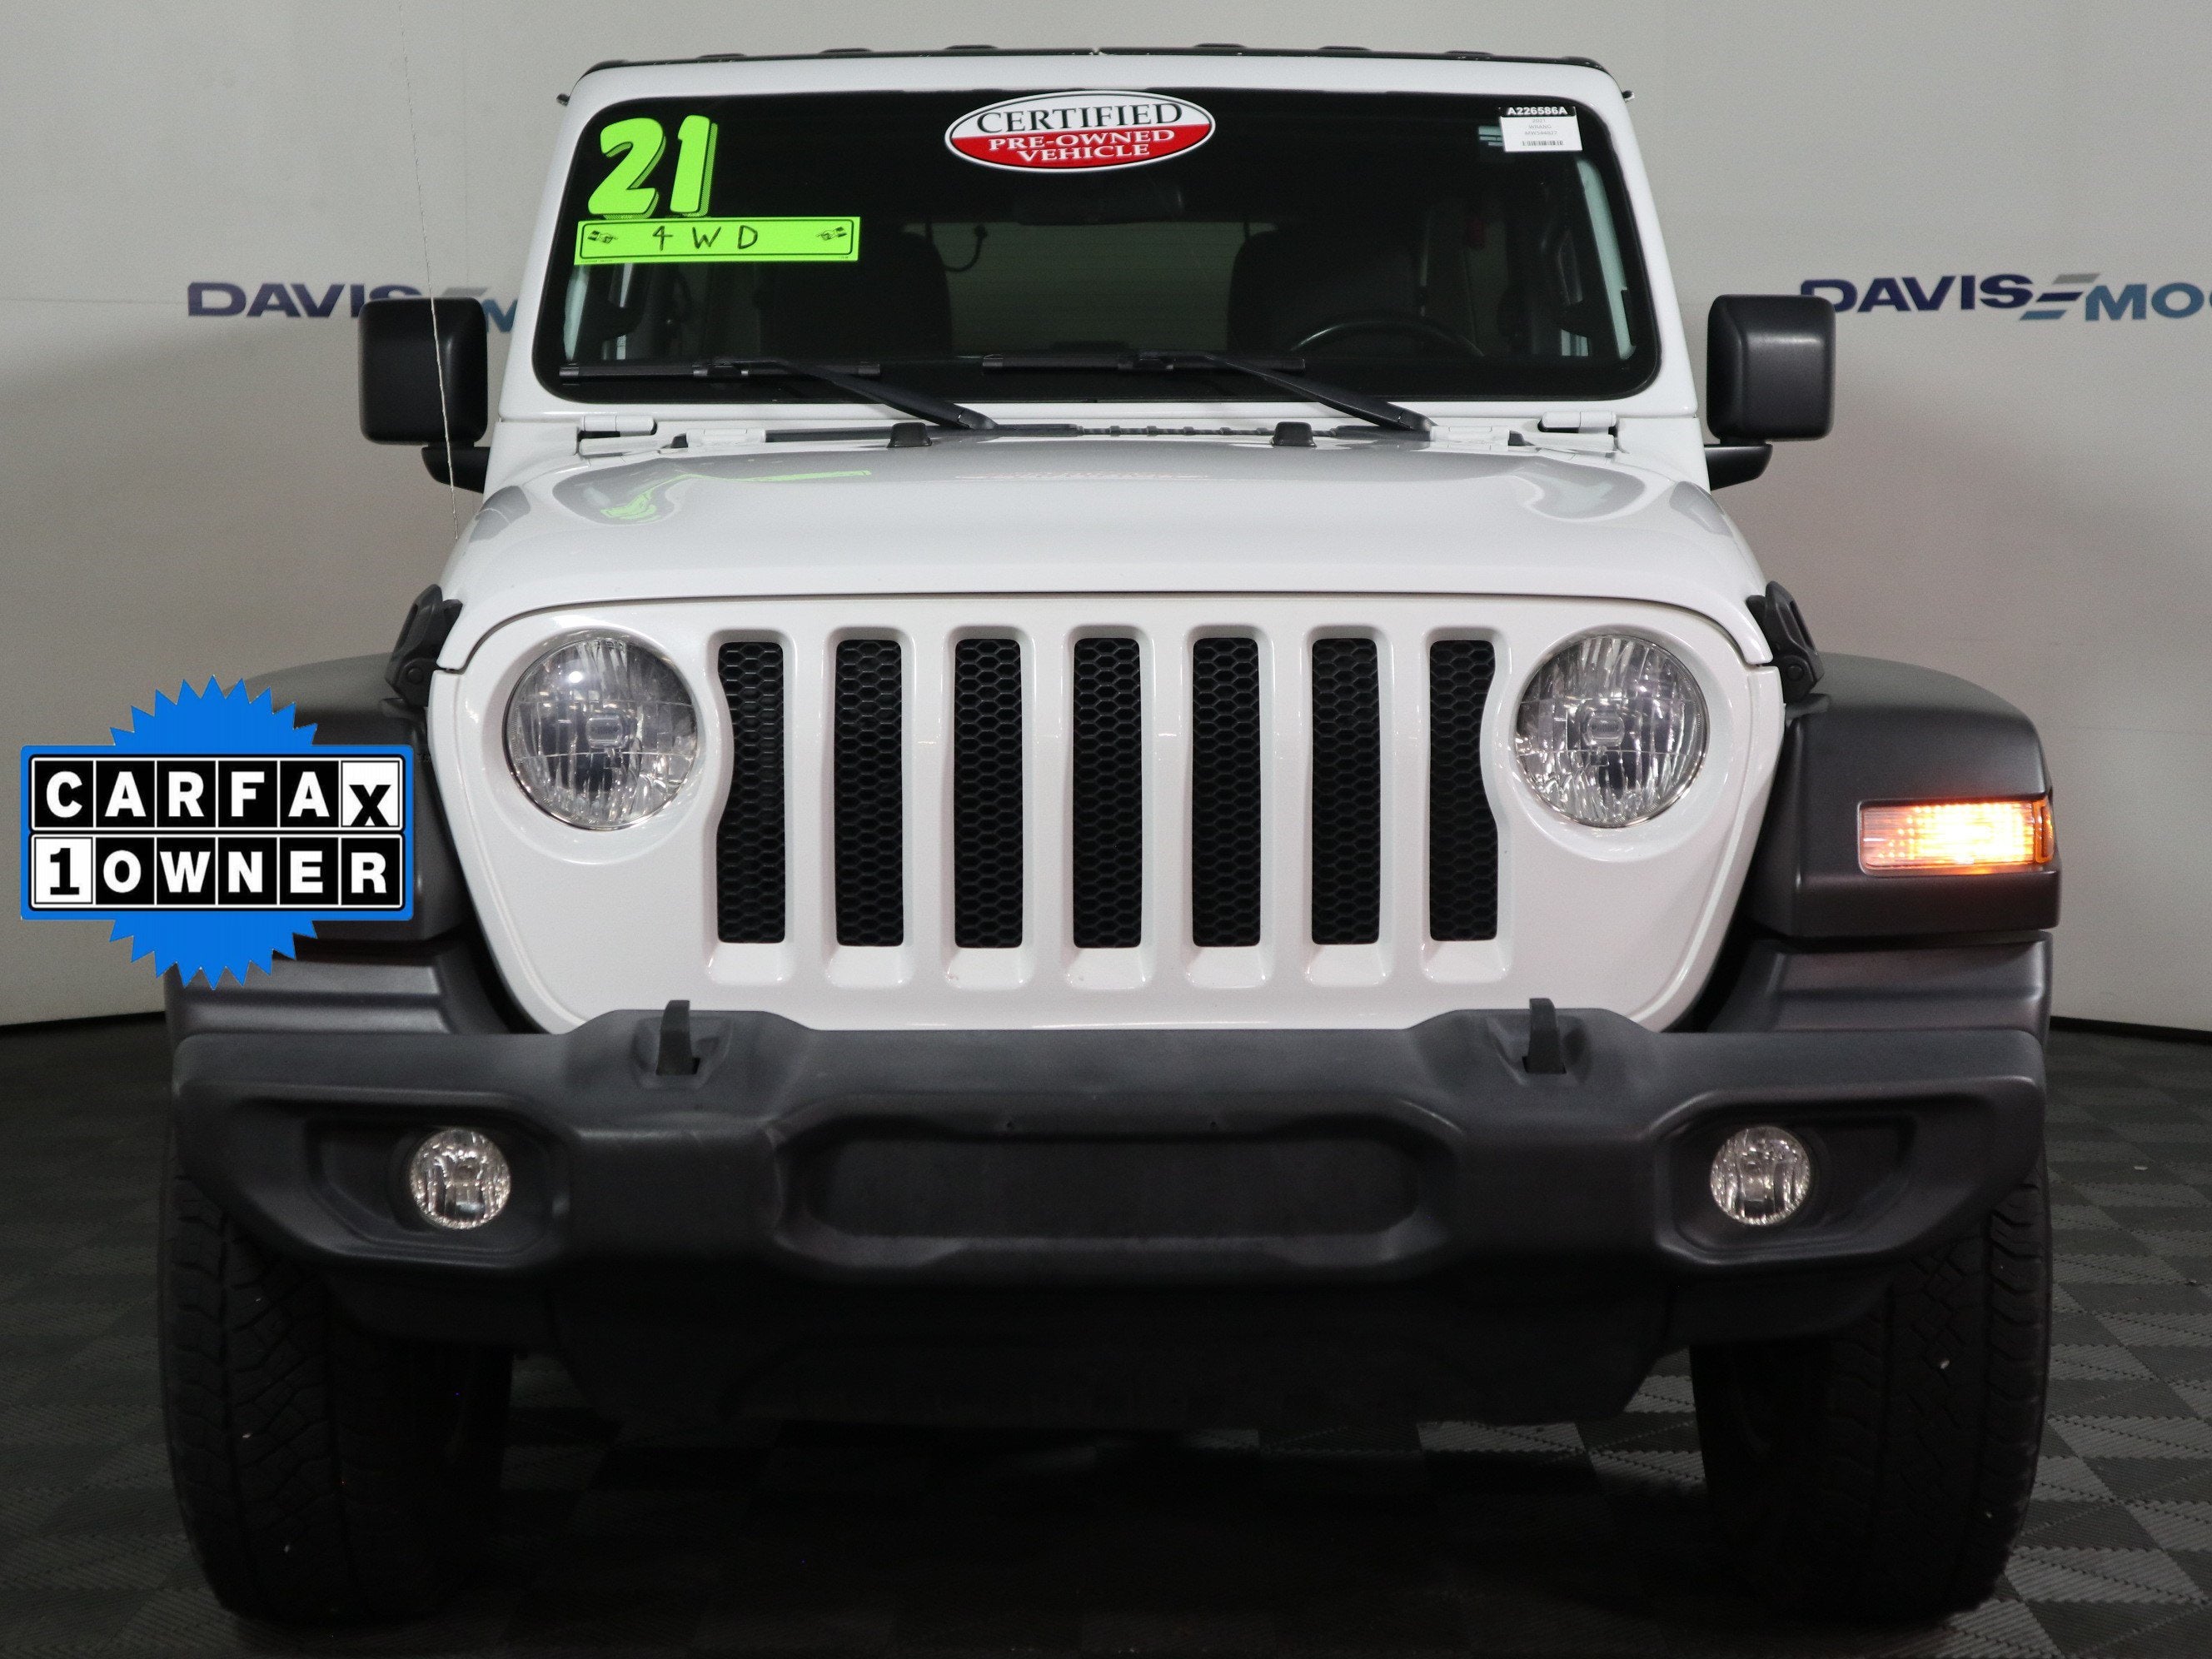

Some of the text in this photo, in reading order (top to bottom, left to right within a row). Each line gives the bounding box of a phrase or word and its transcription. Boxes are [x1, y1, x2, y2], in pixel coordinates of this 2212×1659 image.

[976, 102, 1183, 133] CERTIFIED
[1507, 106, 1568, 116] A226586A
[988, 130, 1175, 151] PRE-OWNED
[1017, 144, 1151, 162] VEHICLE
[587, 114, 718, 219] 21
[1801, 273, 2212, 321] DAVIS MO
